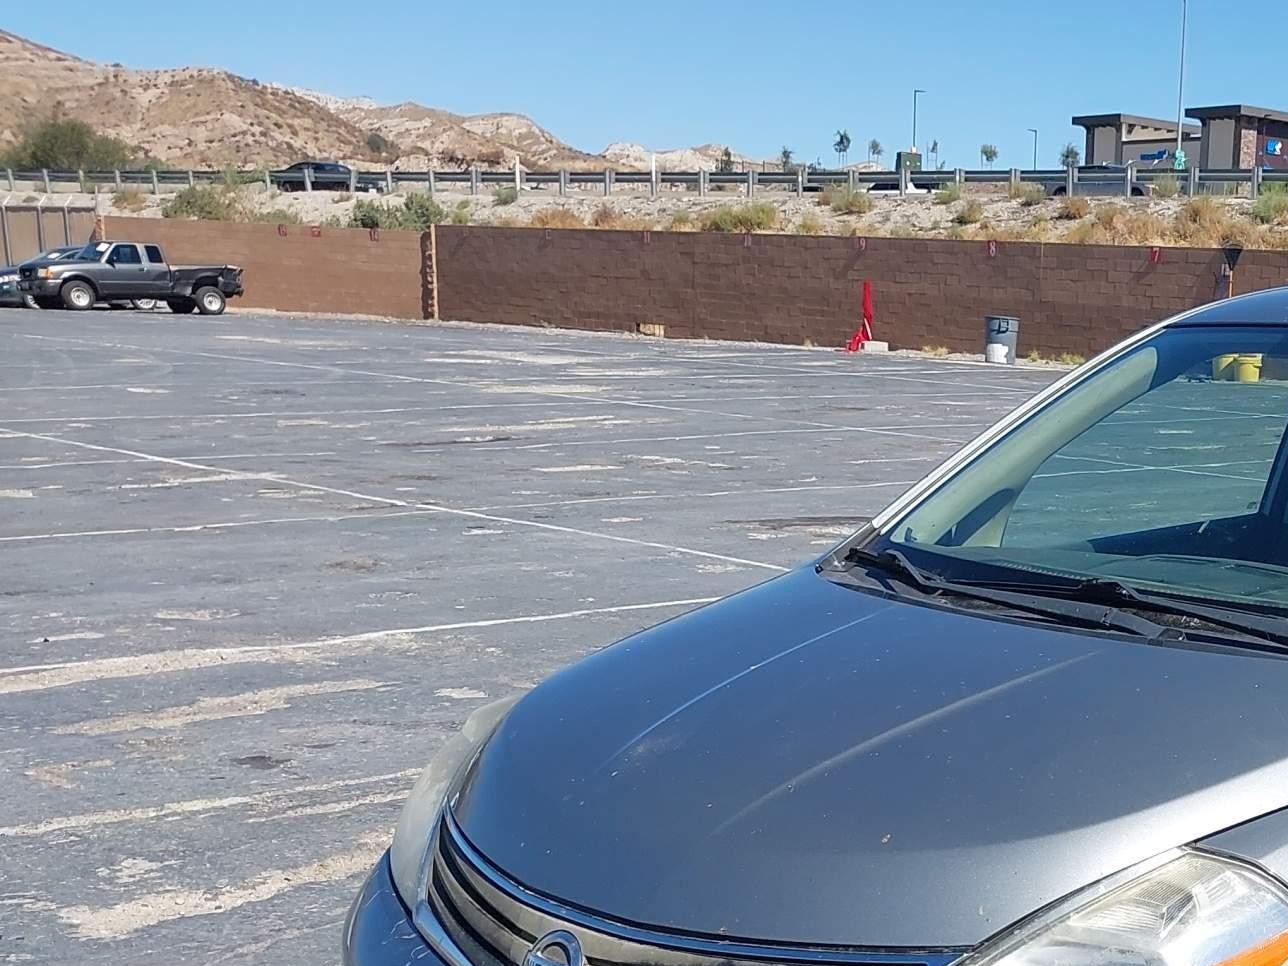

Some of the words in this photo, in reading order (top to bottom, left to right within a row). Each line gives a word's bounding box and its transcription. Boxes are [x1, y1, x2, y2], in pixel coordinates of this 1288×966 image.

[858, 238, 866, 250] 9
[989, 241, 997, 257] 8
[1152, 248, 1161, 262] 7
